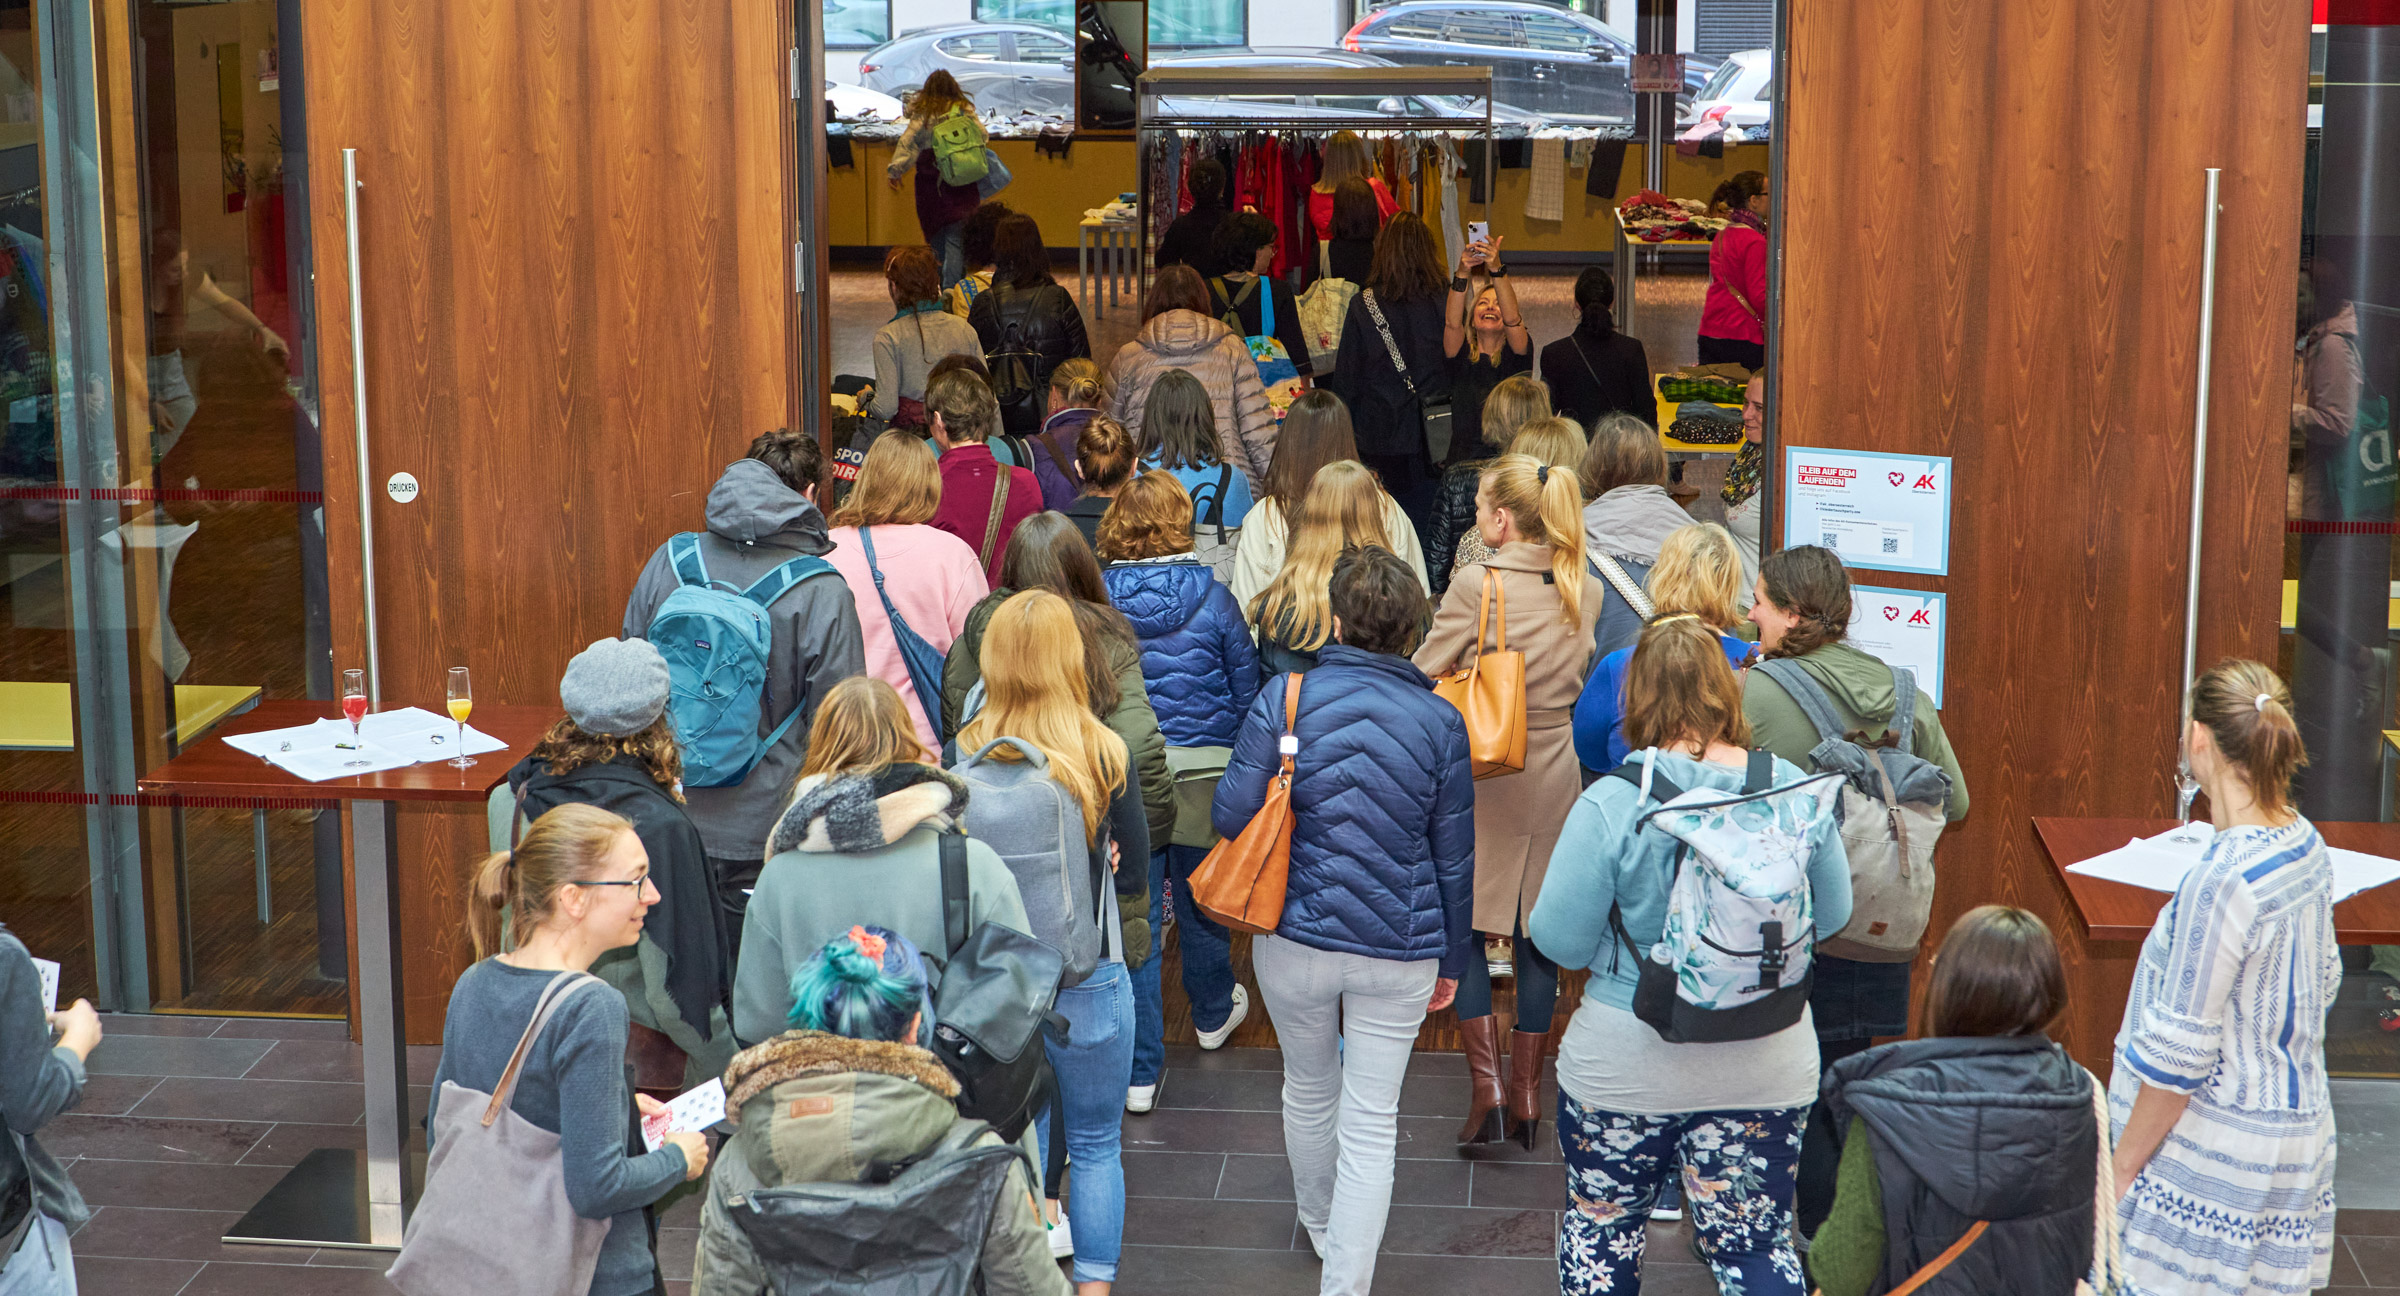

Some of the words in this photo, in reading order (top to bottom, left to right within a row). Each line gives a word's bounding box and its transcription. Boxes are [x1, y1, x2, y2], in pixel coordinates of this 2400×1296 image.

[1799, 466, 1821, 475] BLEIB
[1822, 467, 1838, 476] AUF
[1838, 468, 1856, 477] DEM
[1799, 475, 1844, 486] LAUFENDEN
[1912, 474, 1936, 490] AK
[389, 481, 417, 492] DRÜCKEN
[1907, 609, 1931, 625] AK
